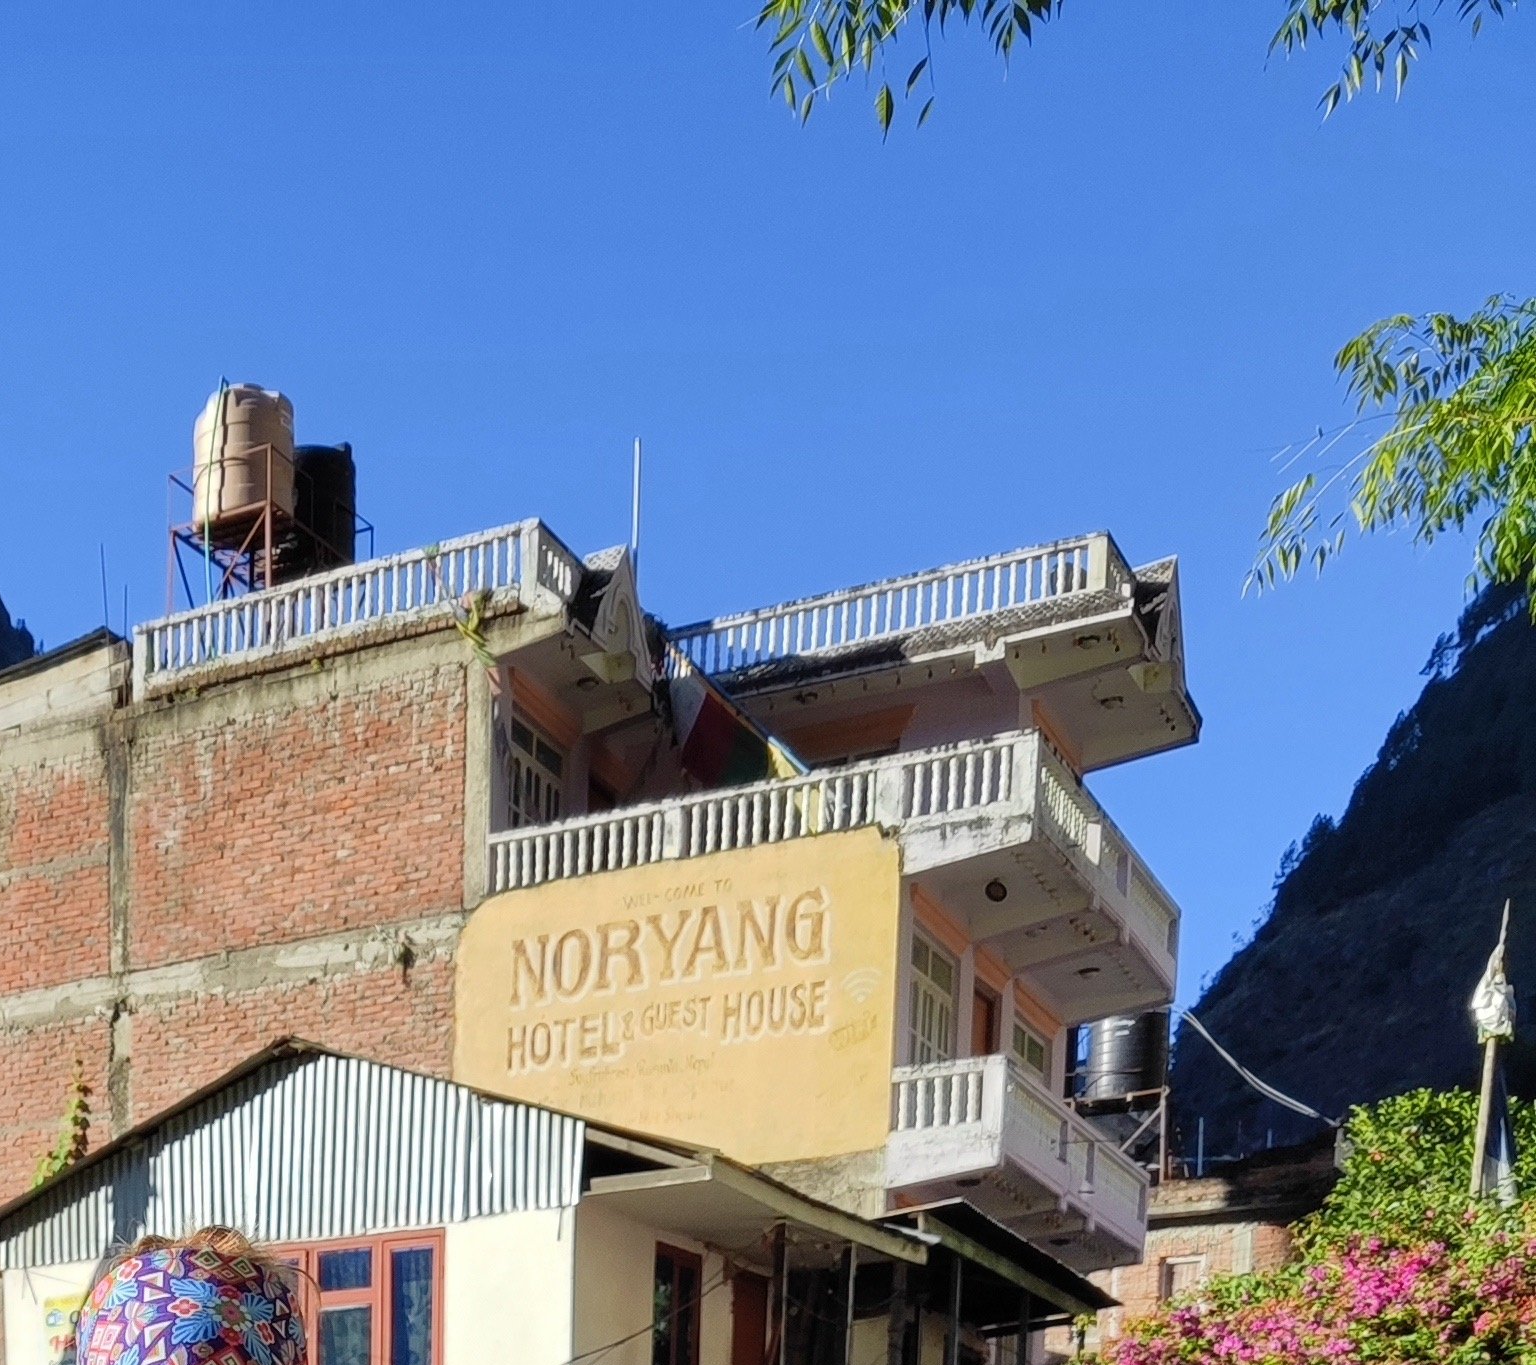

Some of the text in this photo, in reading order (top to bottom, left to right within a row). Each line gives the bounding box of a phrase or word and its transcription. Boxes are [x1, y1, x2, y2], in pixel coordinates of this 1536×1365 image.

[714, 878, 732, 894] TO
[509, 887, 827, 1008] NORYANG
[507, 1011, 621, 1071] HOTEL
[622, 1011, 635, 1041] &
[640, 996, 712, 1036] GUEST
[721, 979, 826, 1040] HOUSE
